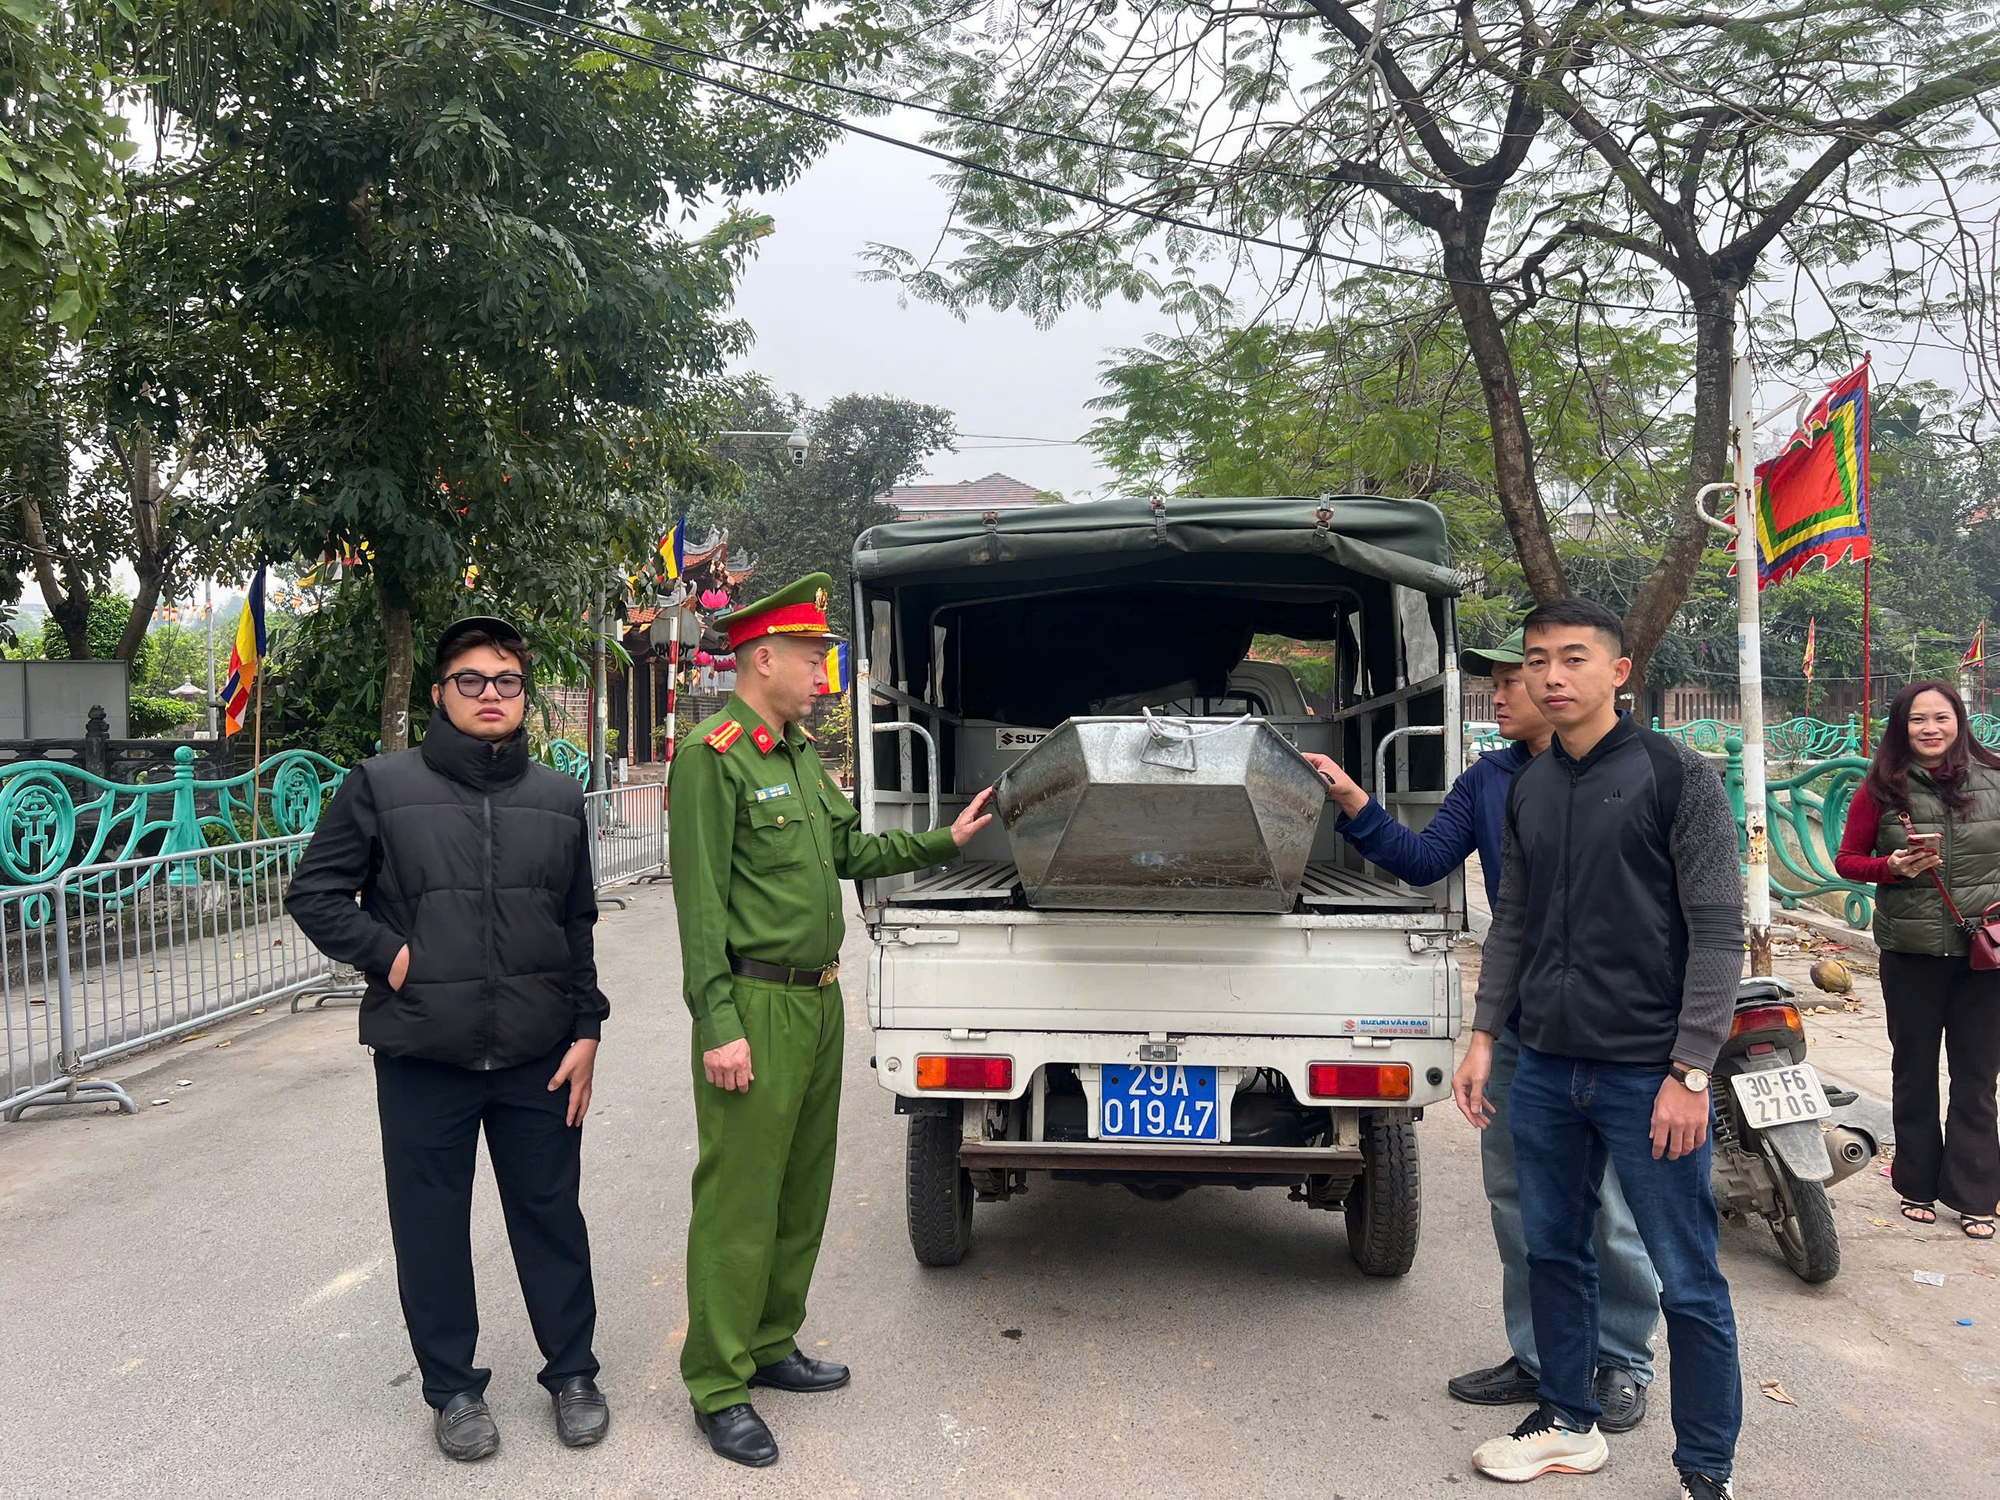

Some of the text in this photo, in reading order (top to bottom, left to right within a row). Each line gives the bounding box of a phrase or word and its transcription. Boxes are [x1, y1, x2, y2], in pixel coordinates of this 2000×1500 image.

[395, 710, 407, 736] 3
[1015, 734, 1047, 744] SUZ
[1128, 1064, 1189, 1097] 29A
[1746, 1069, 1806, 1097] 30-F6
[1104, 1098, 1214, 1136] 019.47
[1755, 1093, 1817, 1122] 2706
